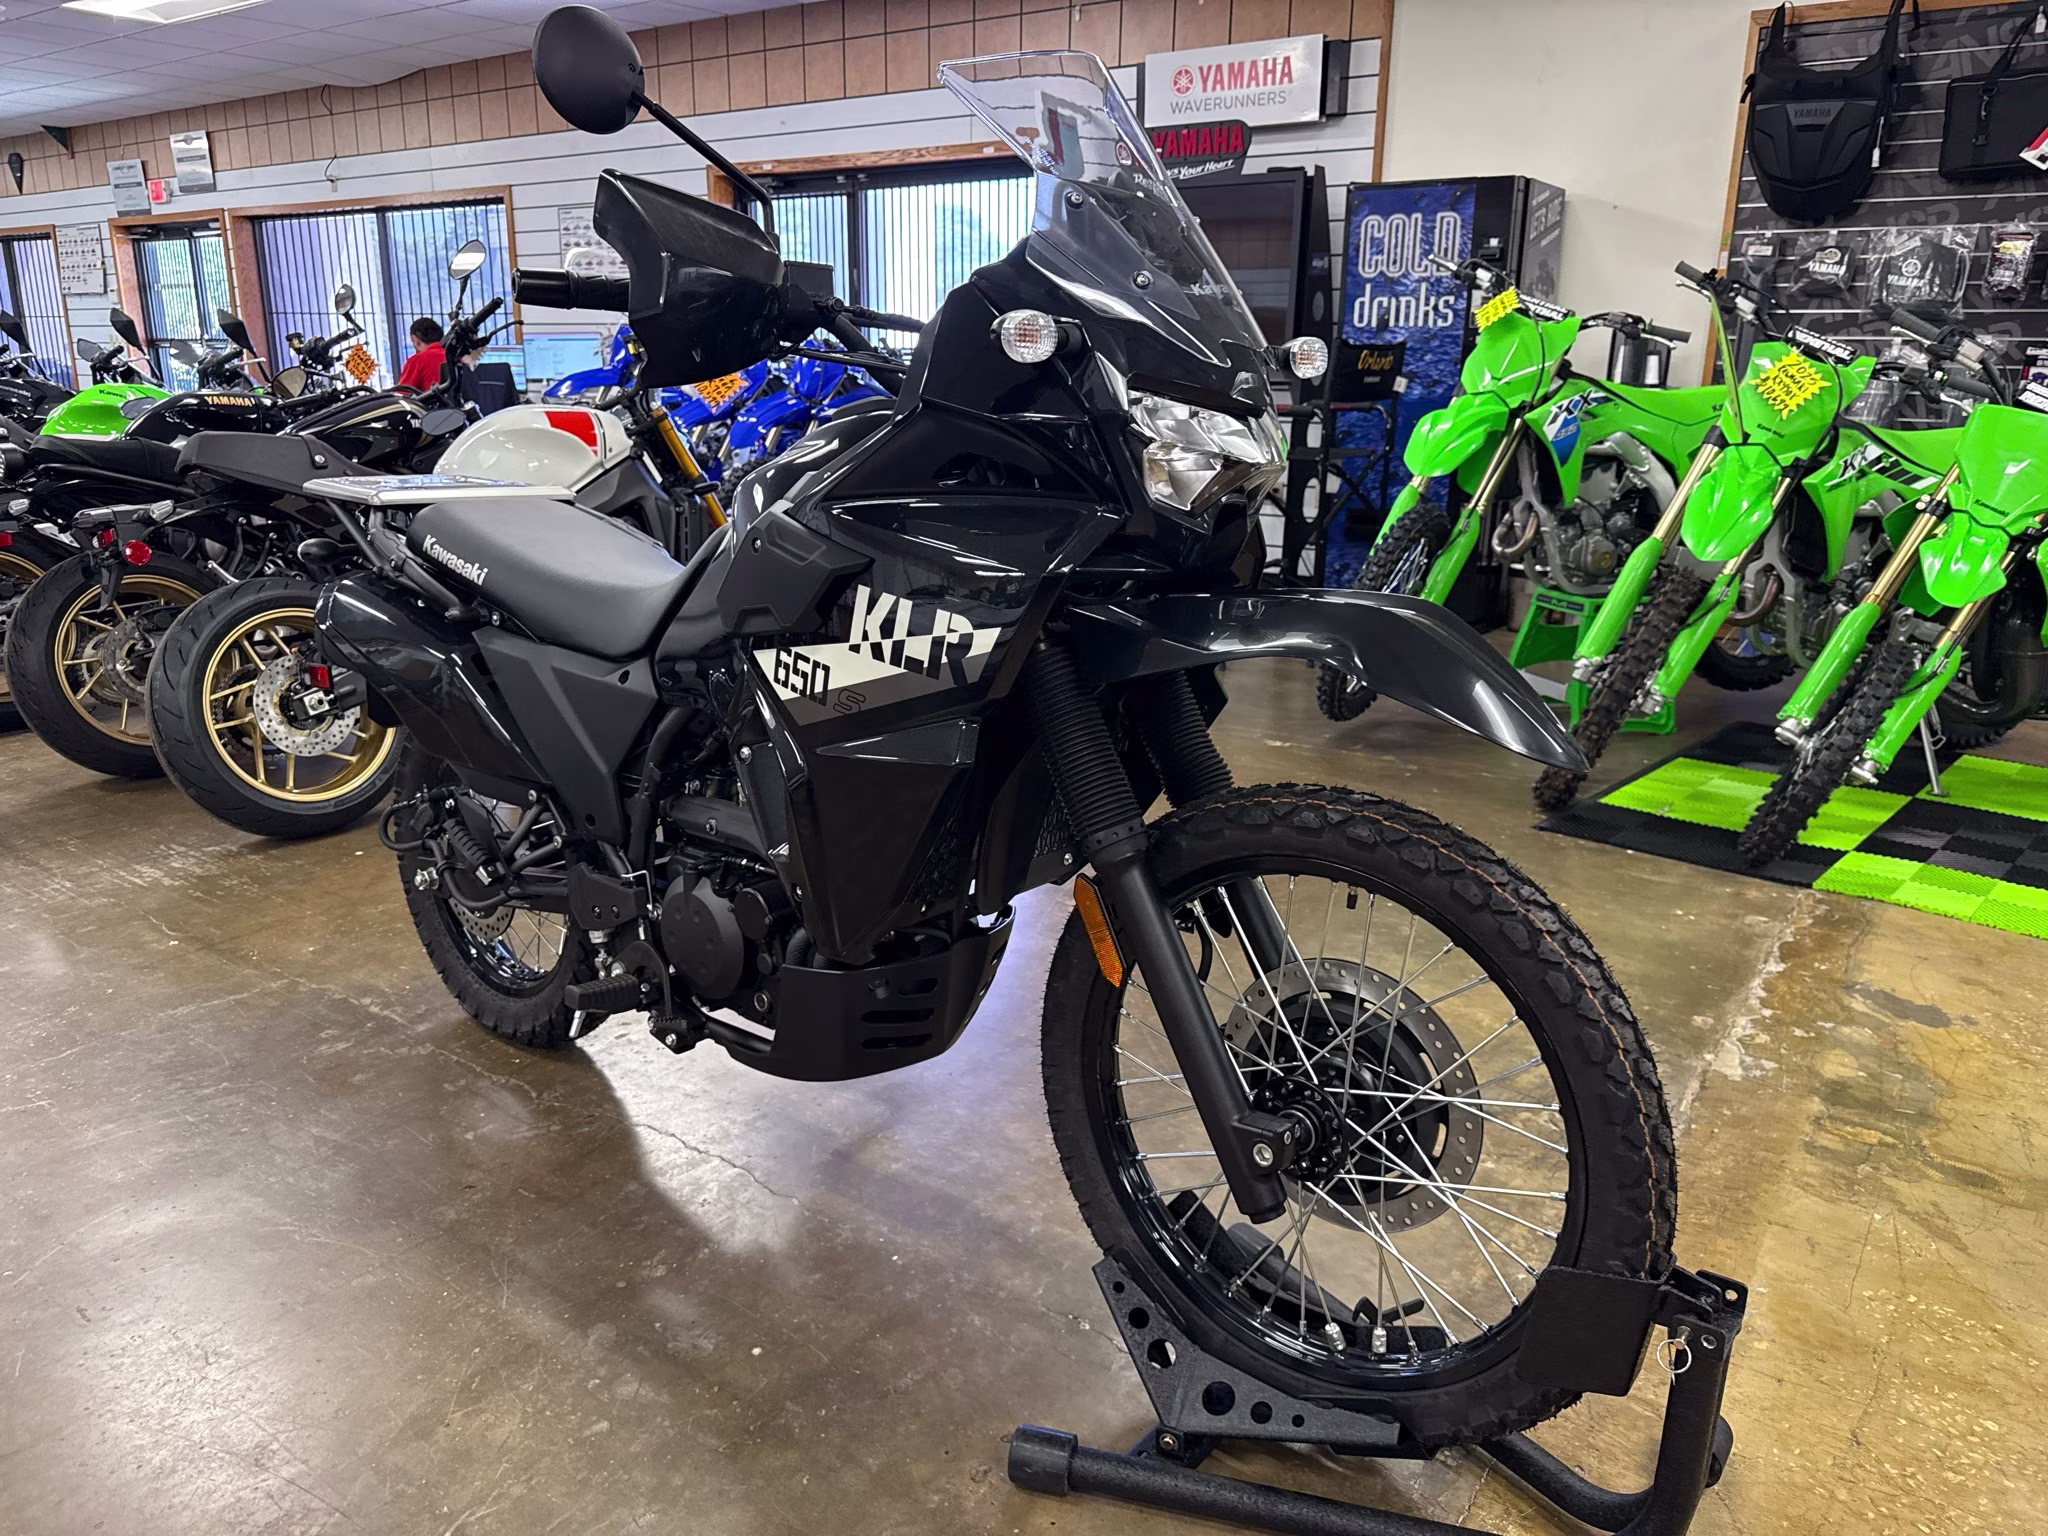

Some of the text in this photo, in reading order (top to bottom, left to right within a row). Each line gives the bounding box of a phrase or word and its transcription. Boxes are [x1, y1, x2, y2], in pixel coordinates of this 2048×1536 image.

[1199, 56, 1293, 93] YAMAHA
[1170, 90, 1287, 115] WAVERUNNERS
[1793, 106, 1831, 119] YAMAHA
[1152, 124, 1244, 158] YAMAHA
[1204, 159, 1235, 173] Heart
[1358, 211, 1461, 278] COLD
[1353, 283, 1455, 328] drinks
[1787, 360, 1817, 386] 2025
[204, 396, 254, 407] YAMAHA
[1548, 389, 1593, 426] KX
[423, 534, 489, 586] Kawasaki
[849, 584, 974, 687] KLR
[774, 645, 831, 707] 650
